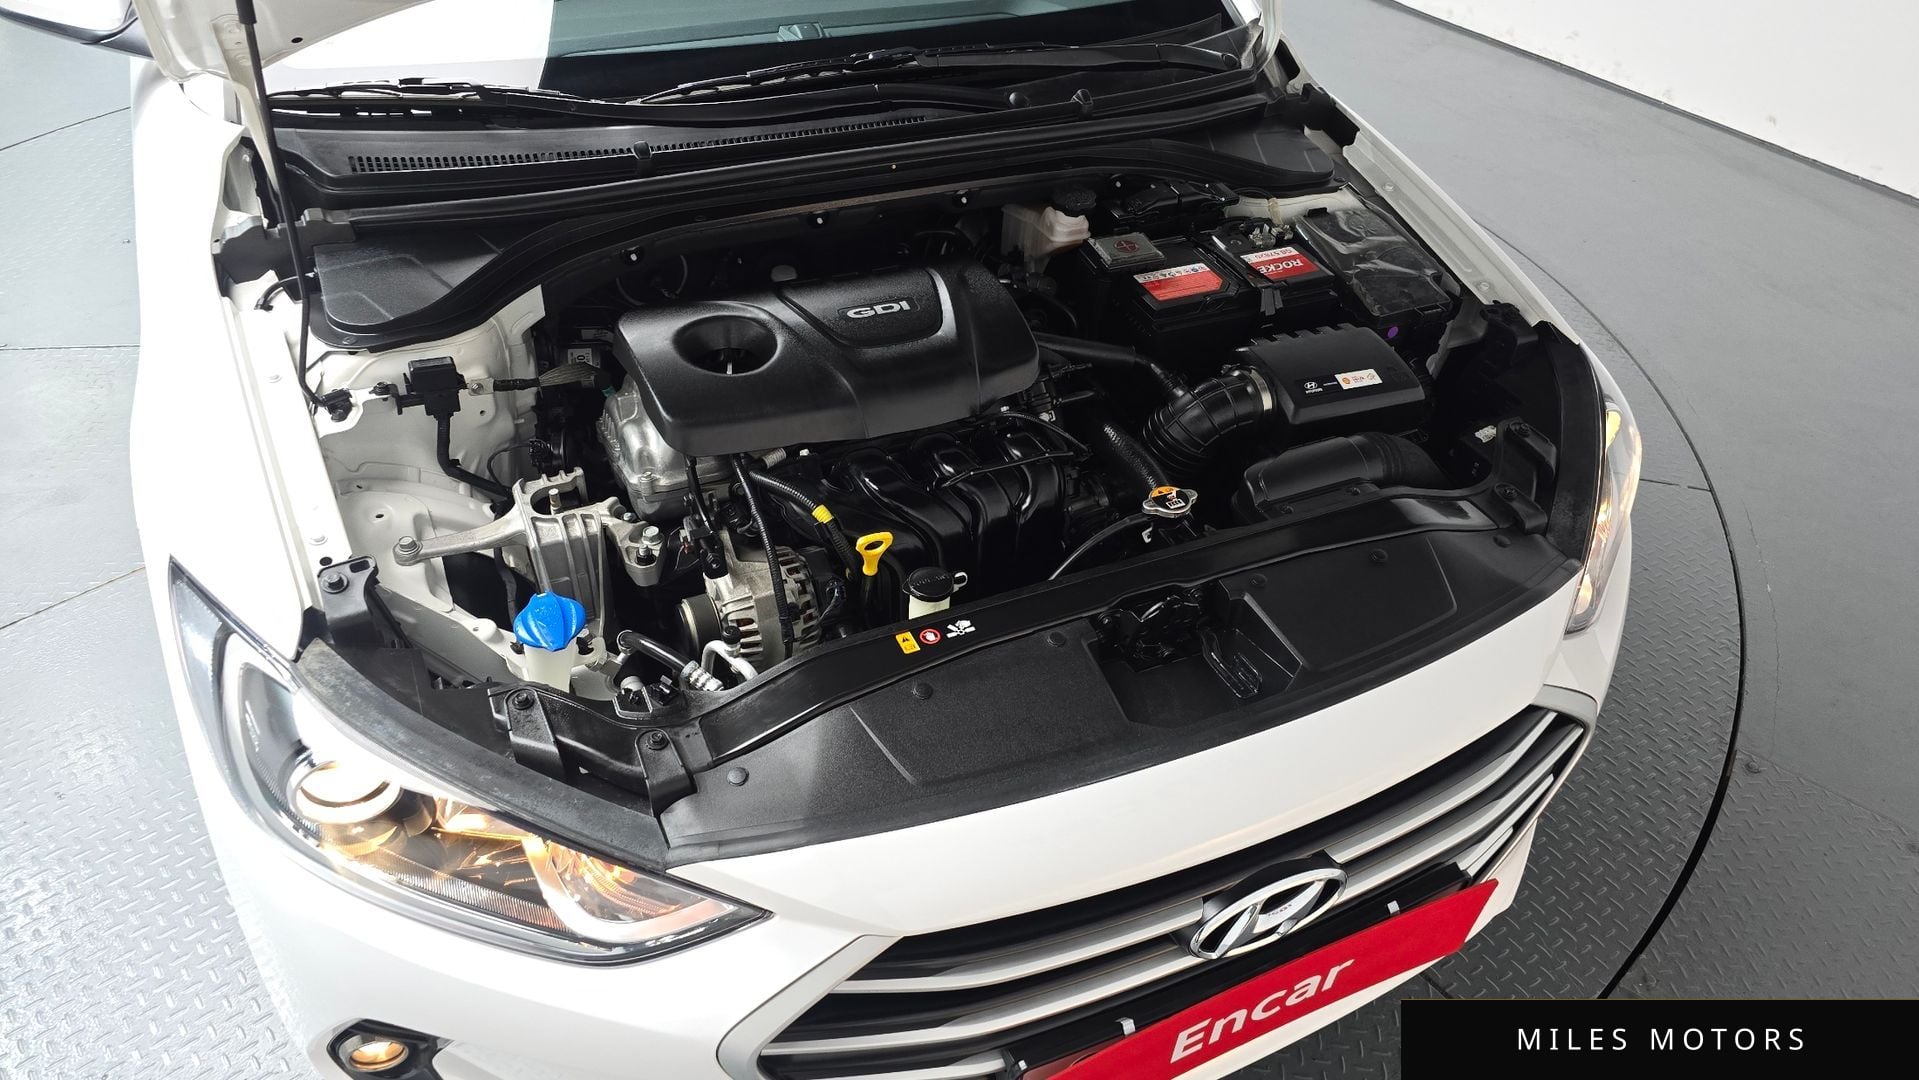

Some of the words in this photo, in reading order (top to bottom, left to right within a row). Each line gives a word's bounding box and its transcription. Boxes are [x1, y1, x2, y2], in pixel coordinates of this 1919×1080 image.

[1256, 258, 1304, 274] ROCKE
[846, 300, 911, 318] GDI
[1170, 959, 1354, 1064] Encar
